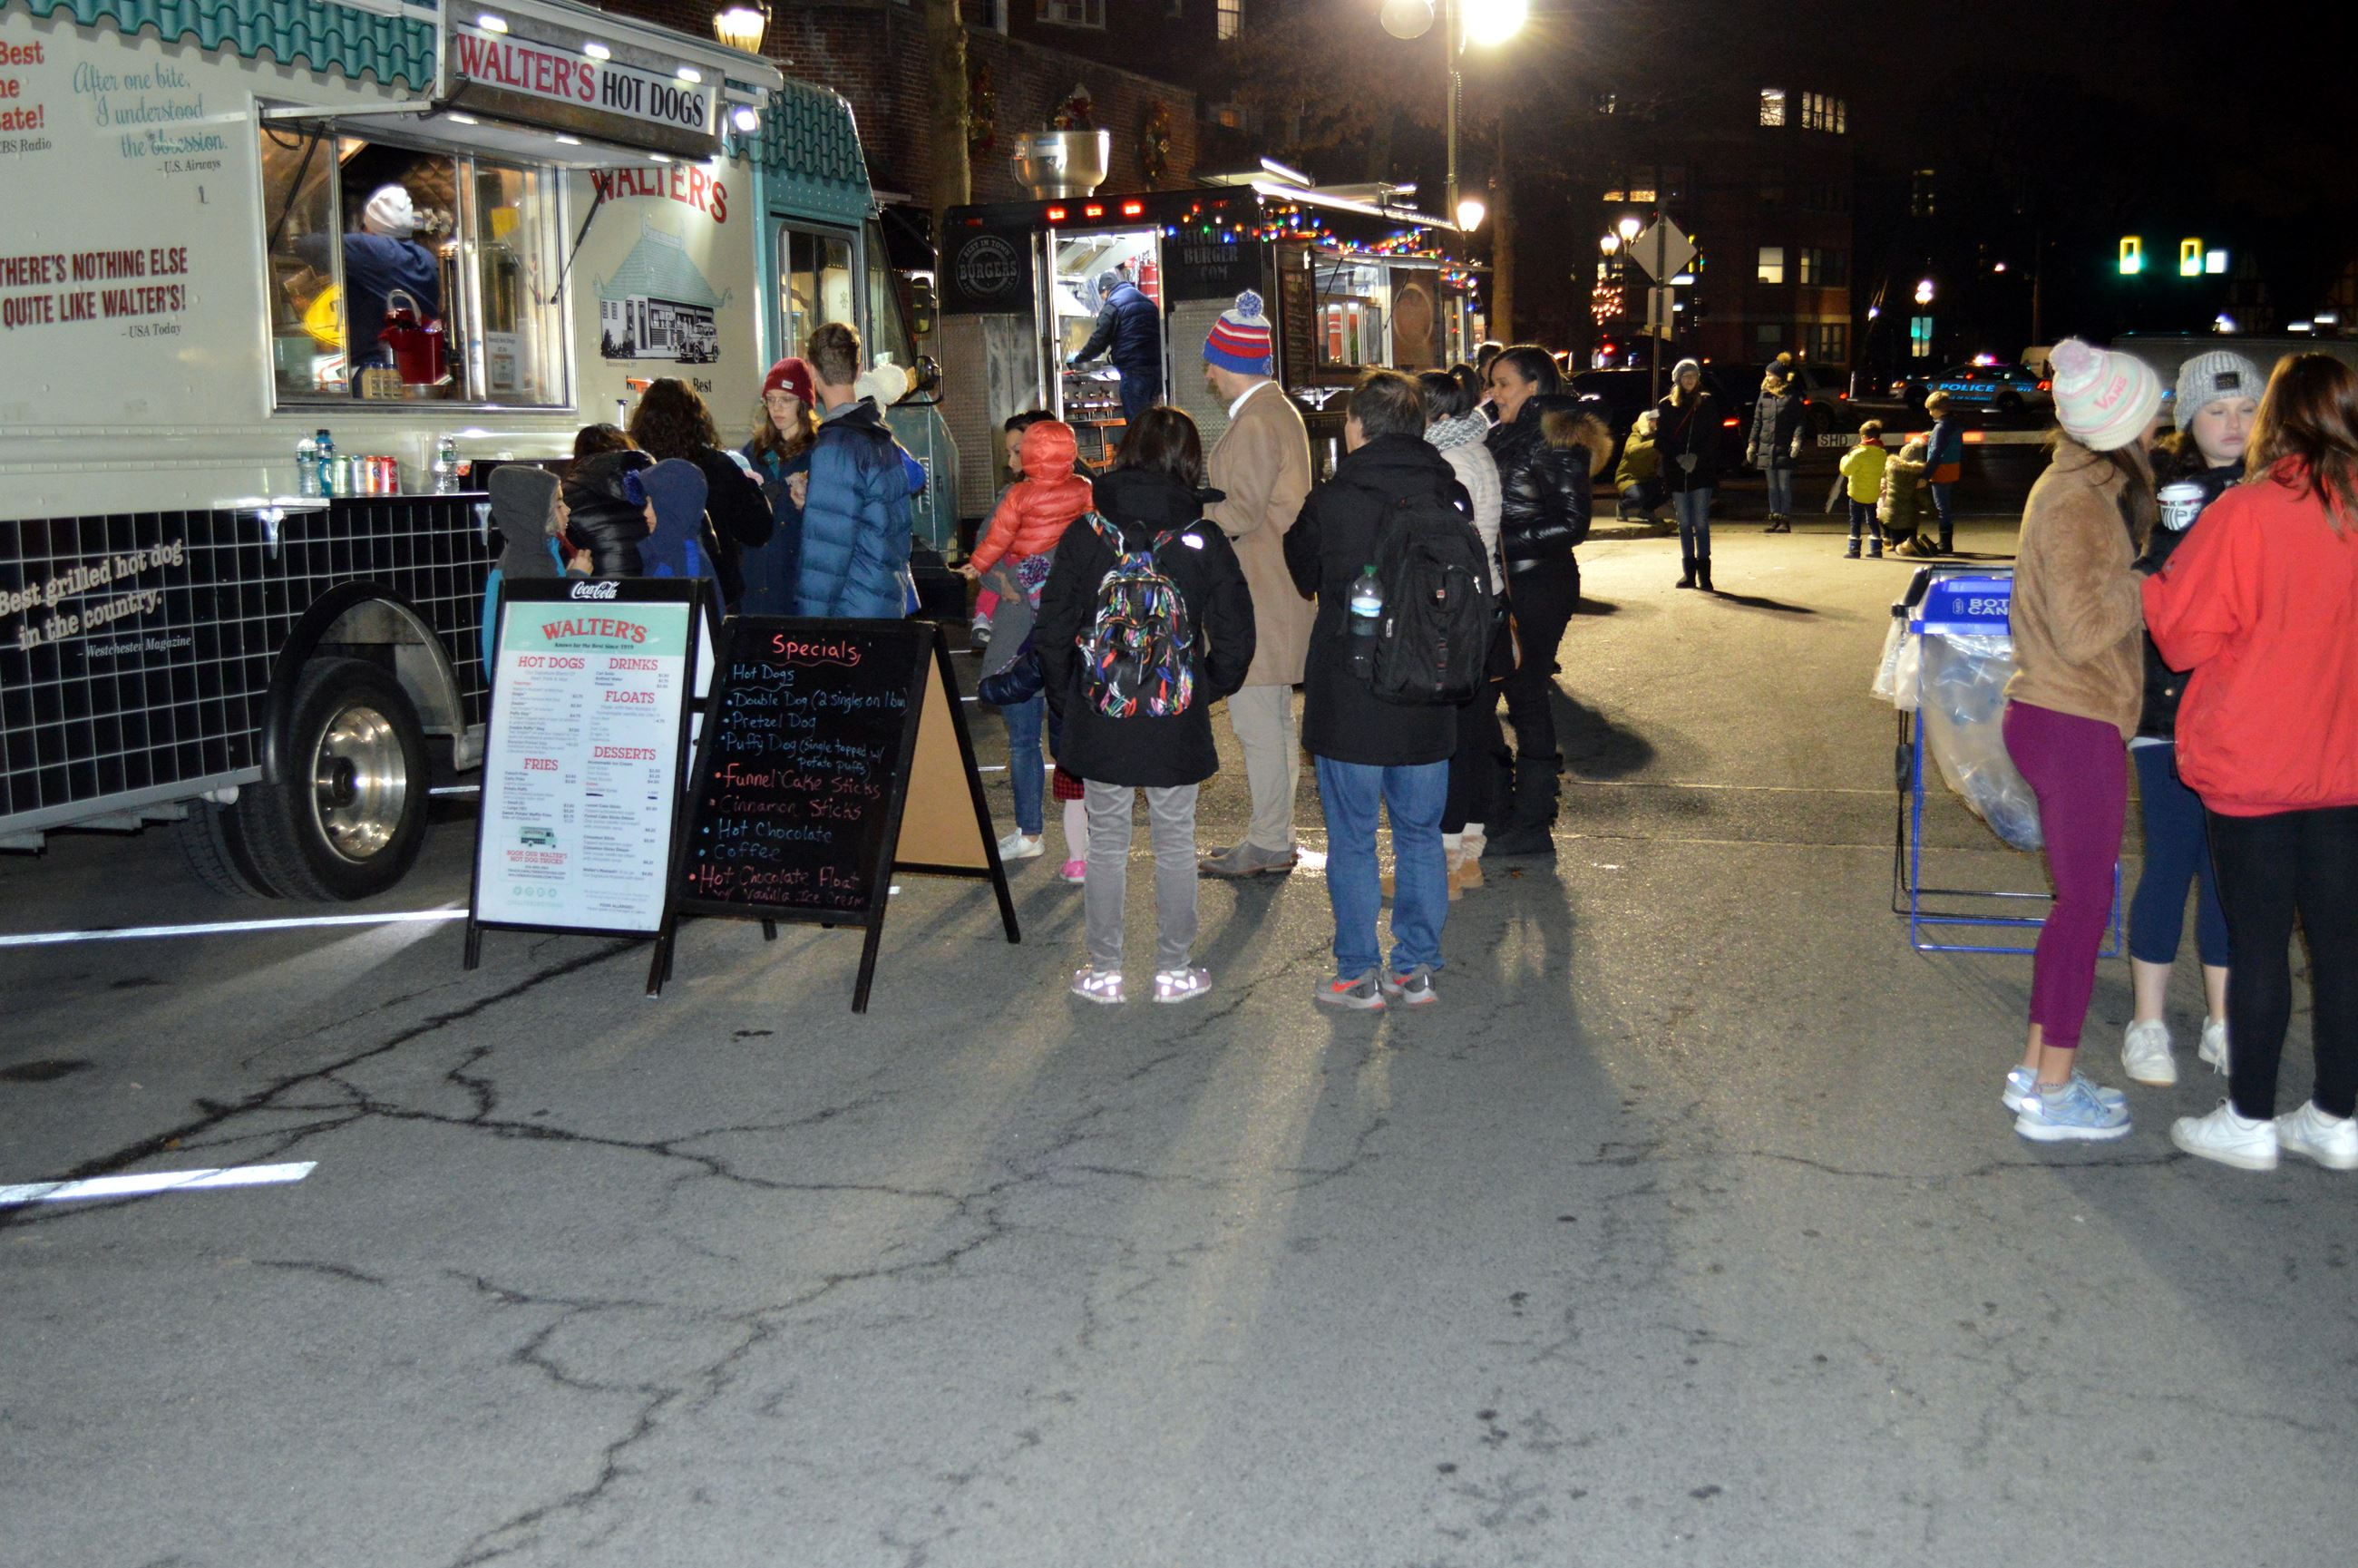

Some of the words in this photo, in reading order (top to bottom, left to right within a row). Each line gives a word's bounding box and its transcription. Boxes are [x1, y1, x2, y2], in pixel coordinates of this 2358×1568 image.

[73, 61, 118, 101] After
[124, 73, 151, 89] one
[457, 34, 596, 102] WALTER'S
[602, 71, 645, 112] HOT
[650, 83, 705, 128] DOGS
[0, 103, 44, 131] ate!
[115, 93, 205, 125] understood
[0, 140, 17, 154] BS
[20, 138, 52, 152] Radio
[122, 134, 146, 158] the
[185, 159, 222, 172] Airways
[590, 166, 727, 224] WALTER'S
[0, 254, 67, 288] THERE'S
[73, 248, 146, 282] NOTHING
[151, 247, 189, 276] ELSE
[959, 259, 1018, 280] BURGERS
[3, 294, 54, 331] QUITE
[60, 291, 97, 322] LIKE
[102, 284, 186, 318] WALTER'S!
[129, 326, 151, 339] USA
[152, 321, 182, 336] Today
[693, 377, 713, 393] Best
[1939, 384, 1995, 393] POLICE
[2092, 375, 2129, 410] VANS
[1820, 434, 1848, 447] SHD
[0, 582, 42, 617] Best
[45, 564, 112, 607] grilled
[115, 550, 147, 579] hot
[151, 538, 184, 568] dog
[18, 625, 43, 651] in
[46, 613, 80, 641] the
[83, 589, 162, 629] country.
[542, 618, 648, 644] WALTER'S
[86, 640, 143, 658] Westchester
[145, 635, 193, 651] Magazine
[773, 634, 858, 661] Specials
[518, 656, 547, 668] HOT
[548, 657, 585, 669] DOGS
[609, 657, 659, 670] DRINKS
[733, 664, 758, 681] Hot
[762, 664, 795, 685] Dogs
[605, 691, 655, 704] FLOATS
[734, 692, 779, 707] Double
[784, 690, 808, 715] Dog
[732, 711, 784, 729] Pretzel
[787, 713, 816, 738] Dog
[594, 745, 657, 761] DESSERTS
[726, 732, 764, 755] Puffy
[769, 734, 796, 758] Dog
[834, 738, 867, 758] topped
[523, 757, 559, 771] FRIES
[724, 763, 775, 789] Funnel
[780, 769, 823, 792] Cake
[831, 776, 882, 800] Sticks
[720, 794, 797, 817] Cinnamon
[809, 798, 862, 821] Sticks
[718, 818, 748, 840] Hot
[755, 821, 833, 843] Chocolate
[714, 842, 783, 862] Coffee
[699, 864, 735, 893] Hot
[740, 865, 810, 887] Chocolate
[819, 866, 860, 891] Float
